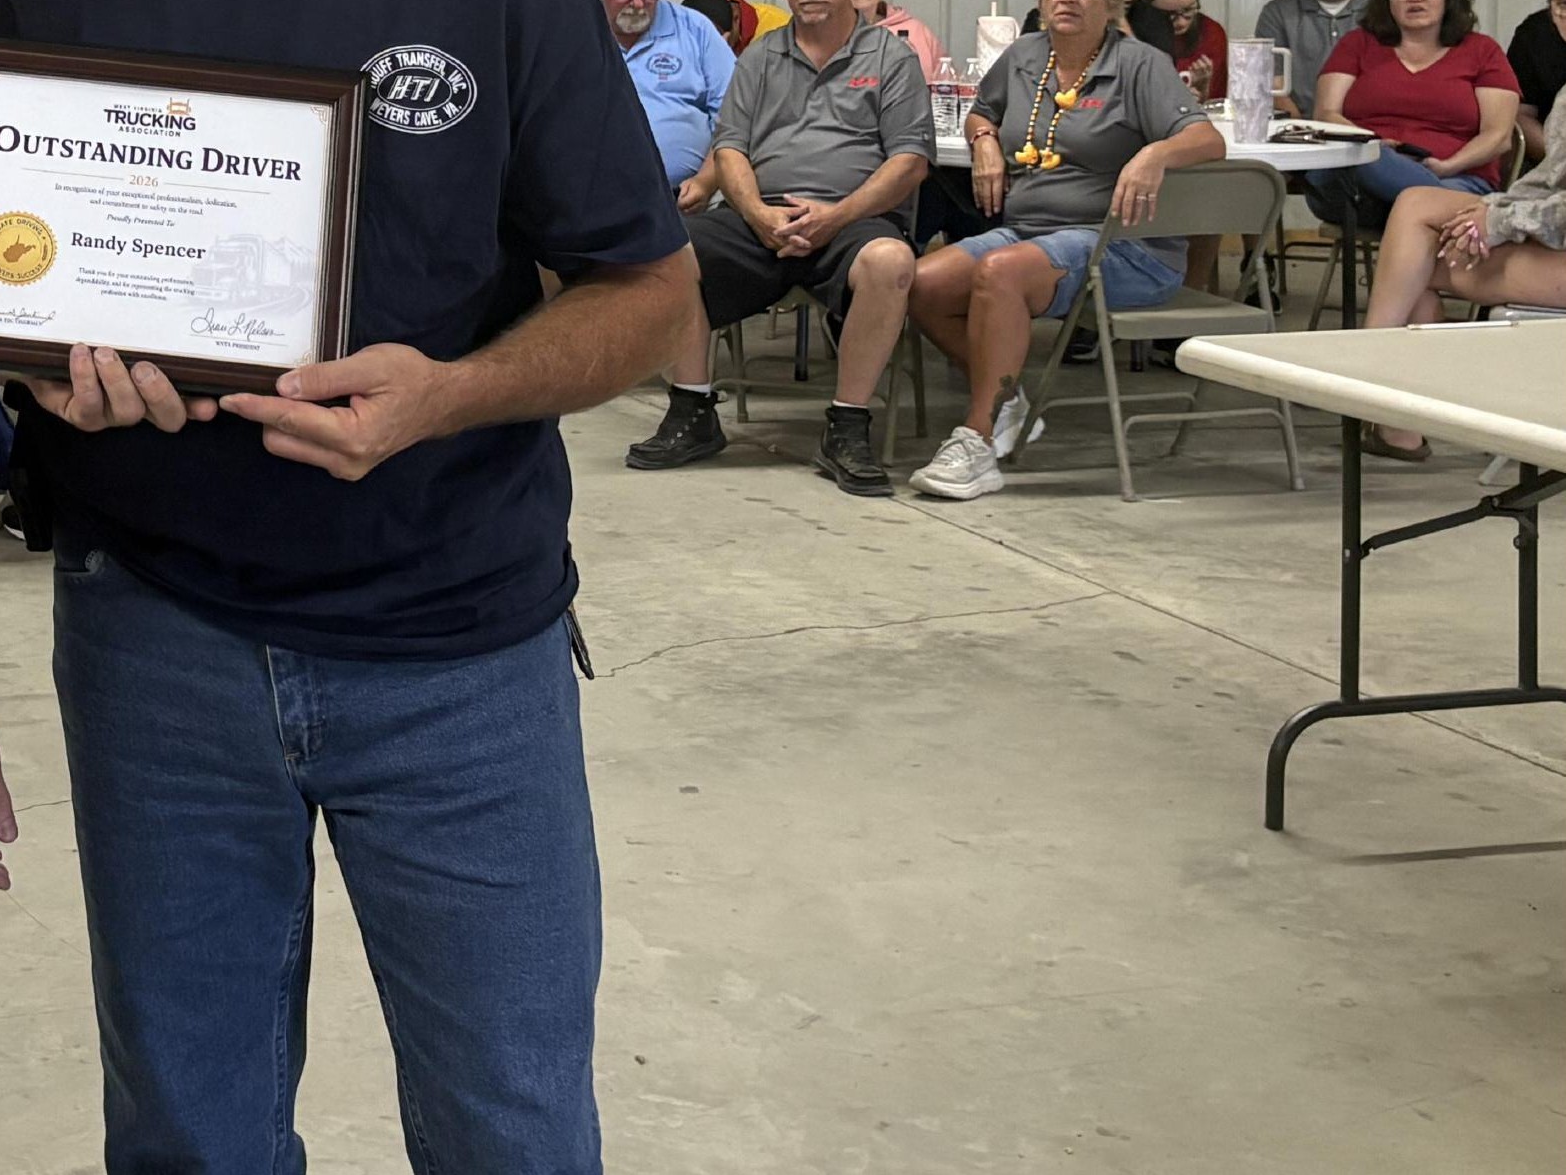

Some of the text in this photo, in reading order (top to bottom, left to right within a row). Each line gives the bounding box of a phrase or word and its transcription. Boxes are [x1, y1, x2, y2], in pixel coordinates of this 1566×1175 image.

[387, 75, 441, 102] HTI
[103, 109, 196, 131] TRUCKING
[118, 126, 181, 137] ASSOCIATION
[200, 147, 301, 181] DRIVER
[129, 174, 159, 187] 2026
[106, 213, 132, 224] Proudly
[133, 216, 165, 226] Presented
[71, 232, 207, 260] Randy Spencer
